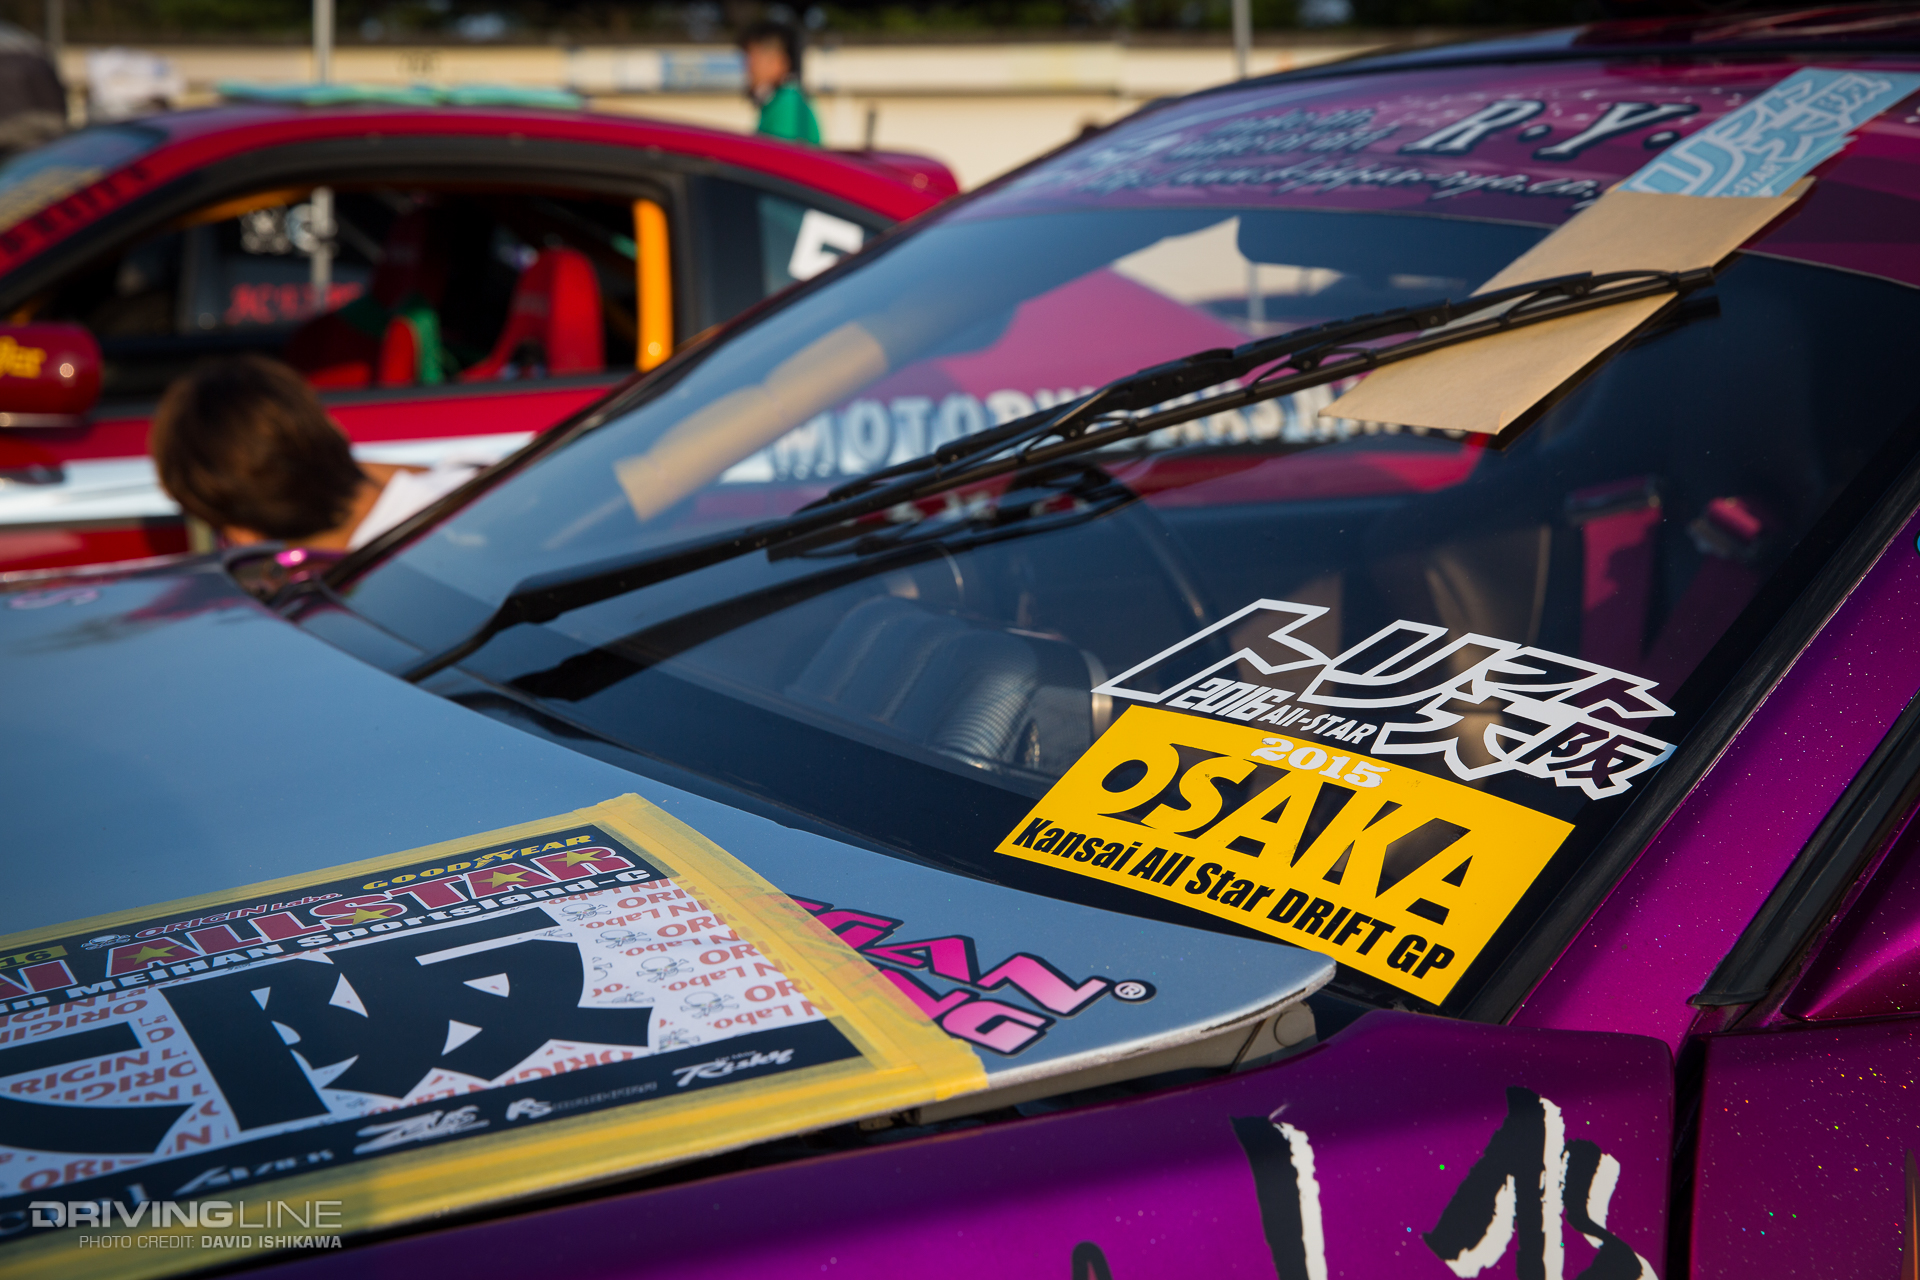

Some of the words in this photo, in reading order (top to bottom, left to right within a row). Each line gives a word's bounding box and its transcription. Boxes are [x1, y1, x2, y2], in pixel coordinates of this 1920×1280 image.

[1166, 677, 1288, 722] 2016
[1251, 737, 1391, 789] 2015
[362, 834, 597, 891] GOODYEAR
[1094, 743, 1476, 926] OSAKA
[65, 944, 284, 999] MEIHAN
[297, 869, 651, 948] Sportsland-C
[105, 846, 635, 979] ALLSTAR
[135, 904, 267, 938] ORIGIN
[1012, 817, 1143, 873] Kansai
[1134, 846, 1190, 888] All
[1187, 861, 1275, 913] Star
[1267, 887, 1396, 957] DRIFT
[1386, 933, 1456, 980] GP
